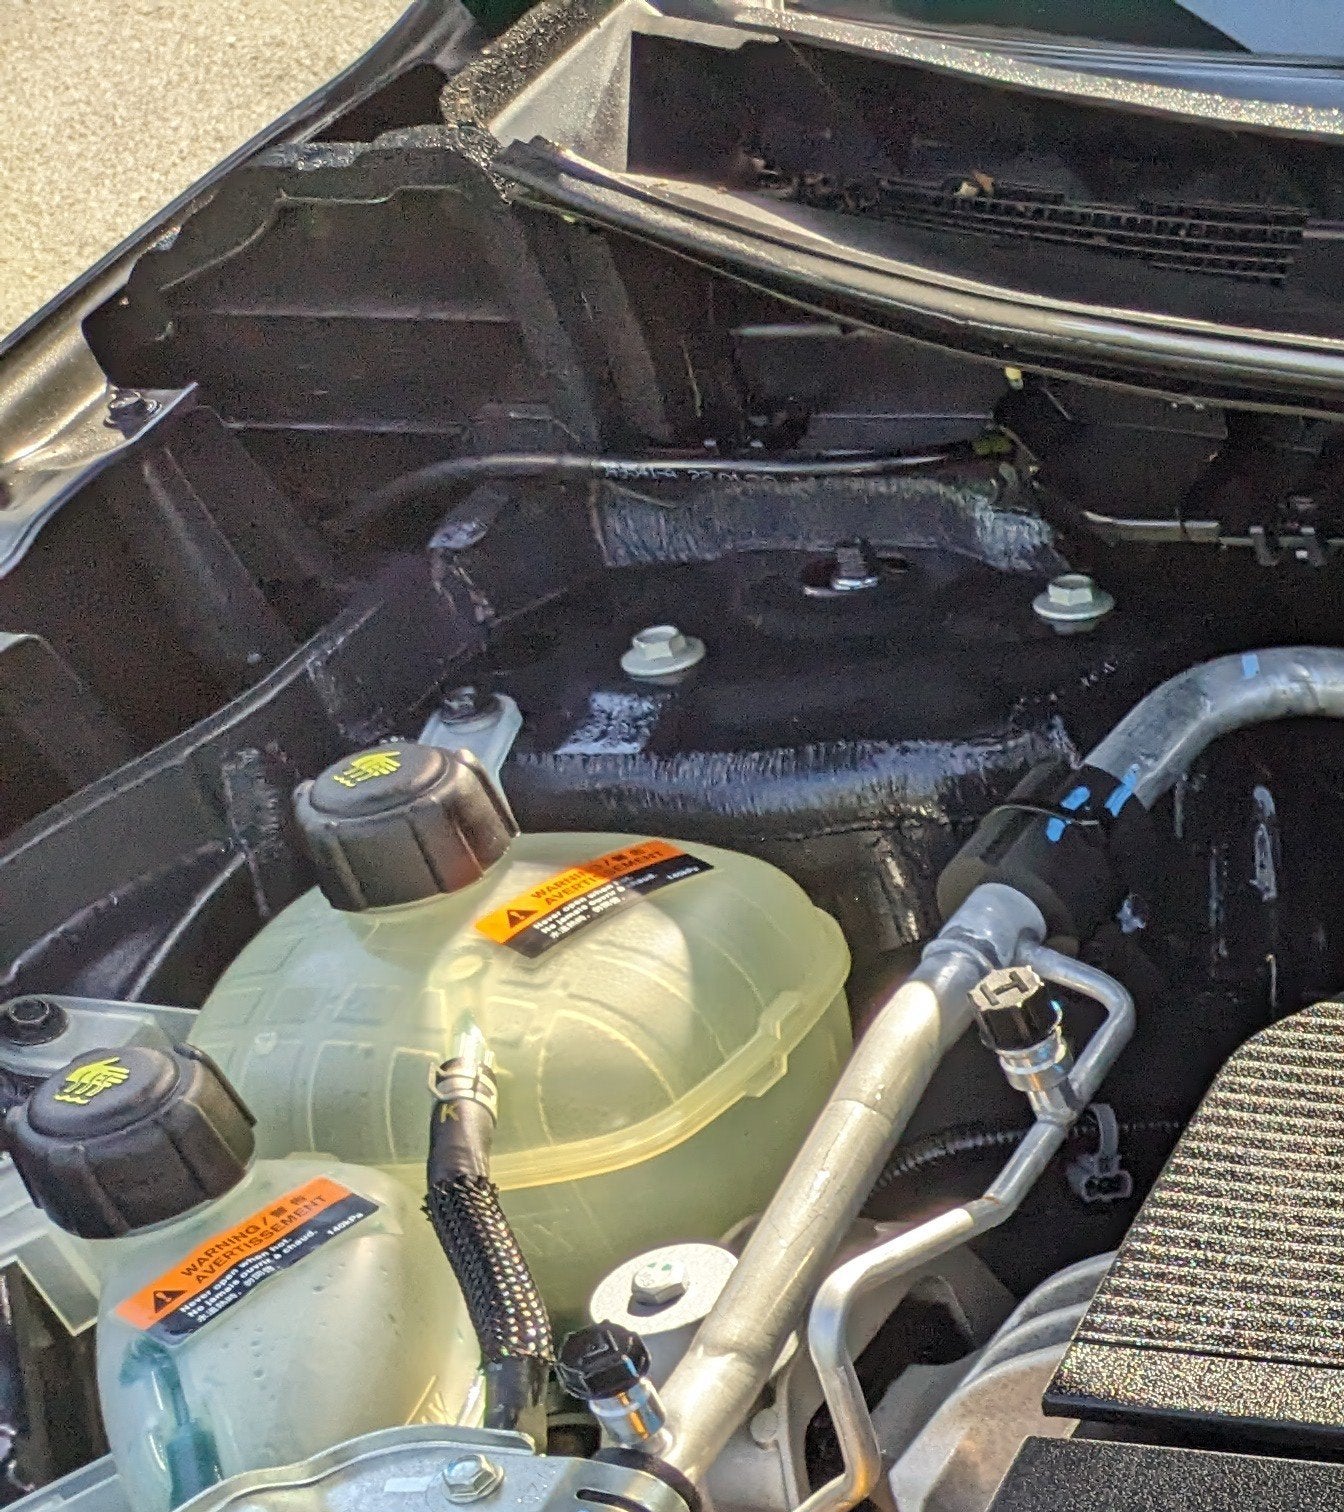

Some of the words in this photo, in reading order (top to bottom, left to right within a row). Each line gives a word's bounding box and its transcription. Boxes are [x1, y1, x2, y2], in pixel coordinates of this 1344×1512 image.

[181, 1224, 262, 1279] WARNING
[196, 1194, 328, 1285] AVERTISSEMENT
[179, 1291, 212, 1314] Never
[213, 1269, 239, 1291] open
[239, 1249, 270, 1269] when
